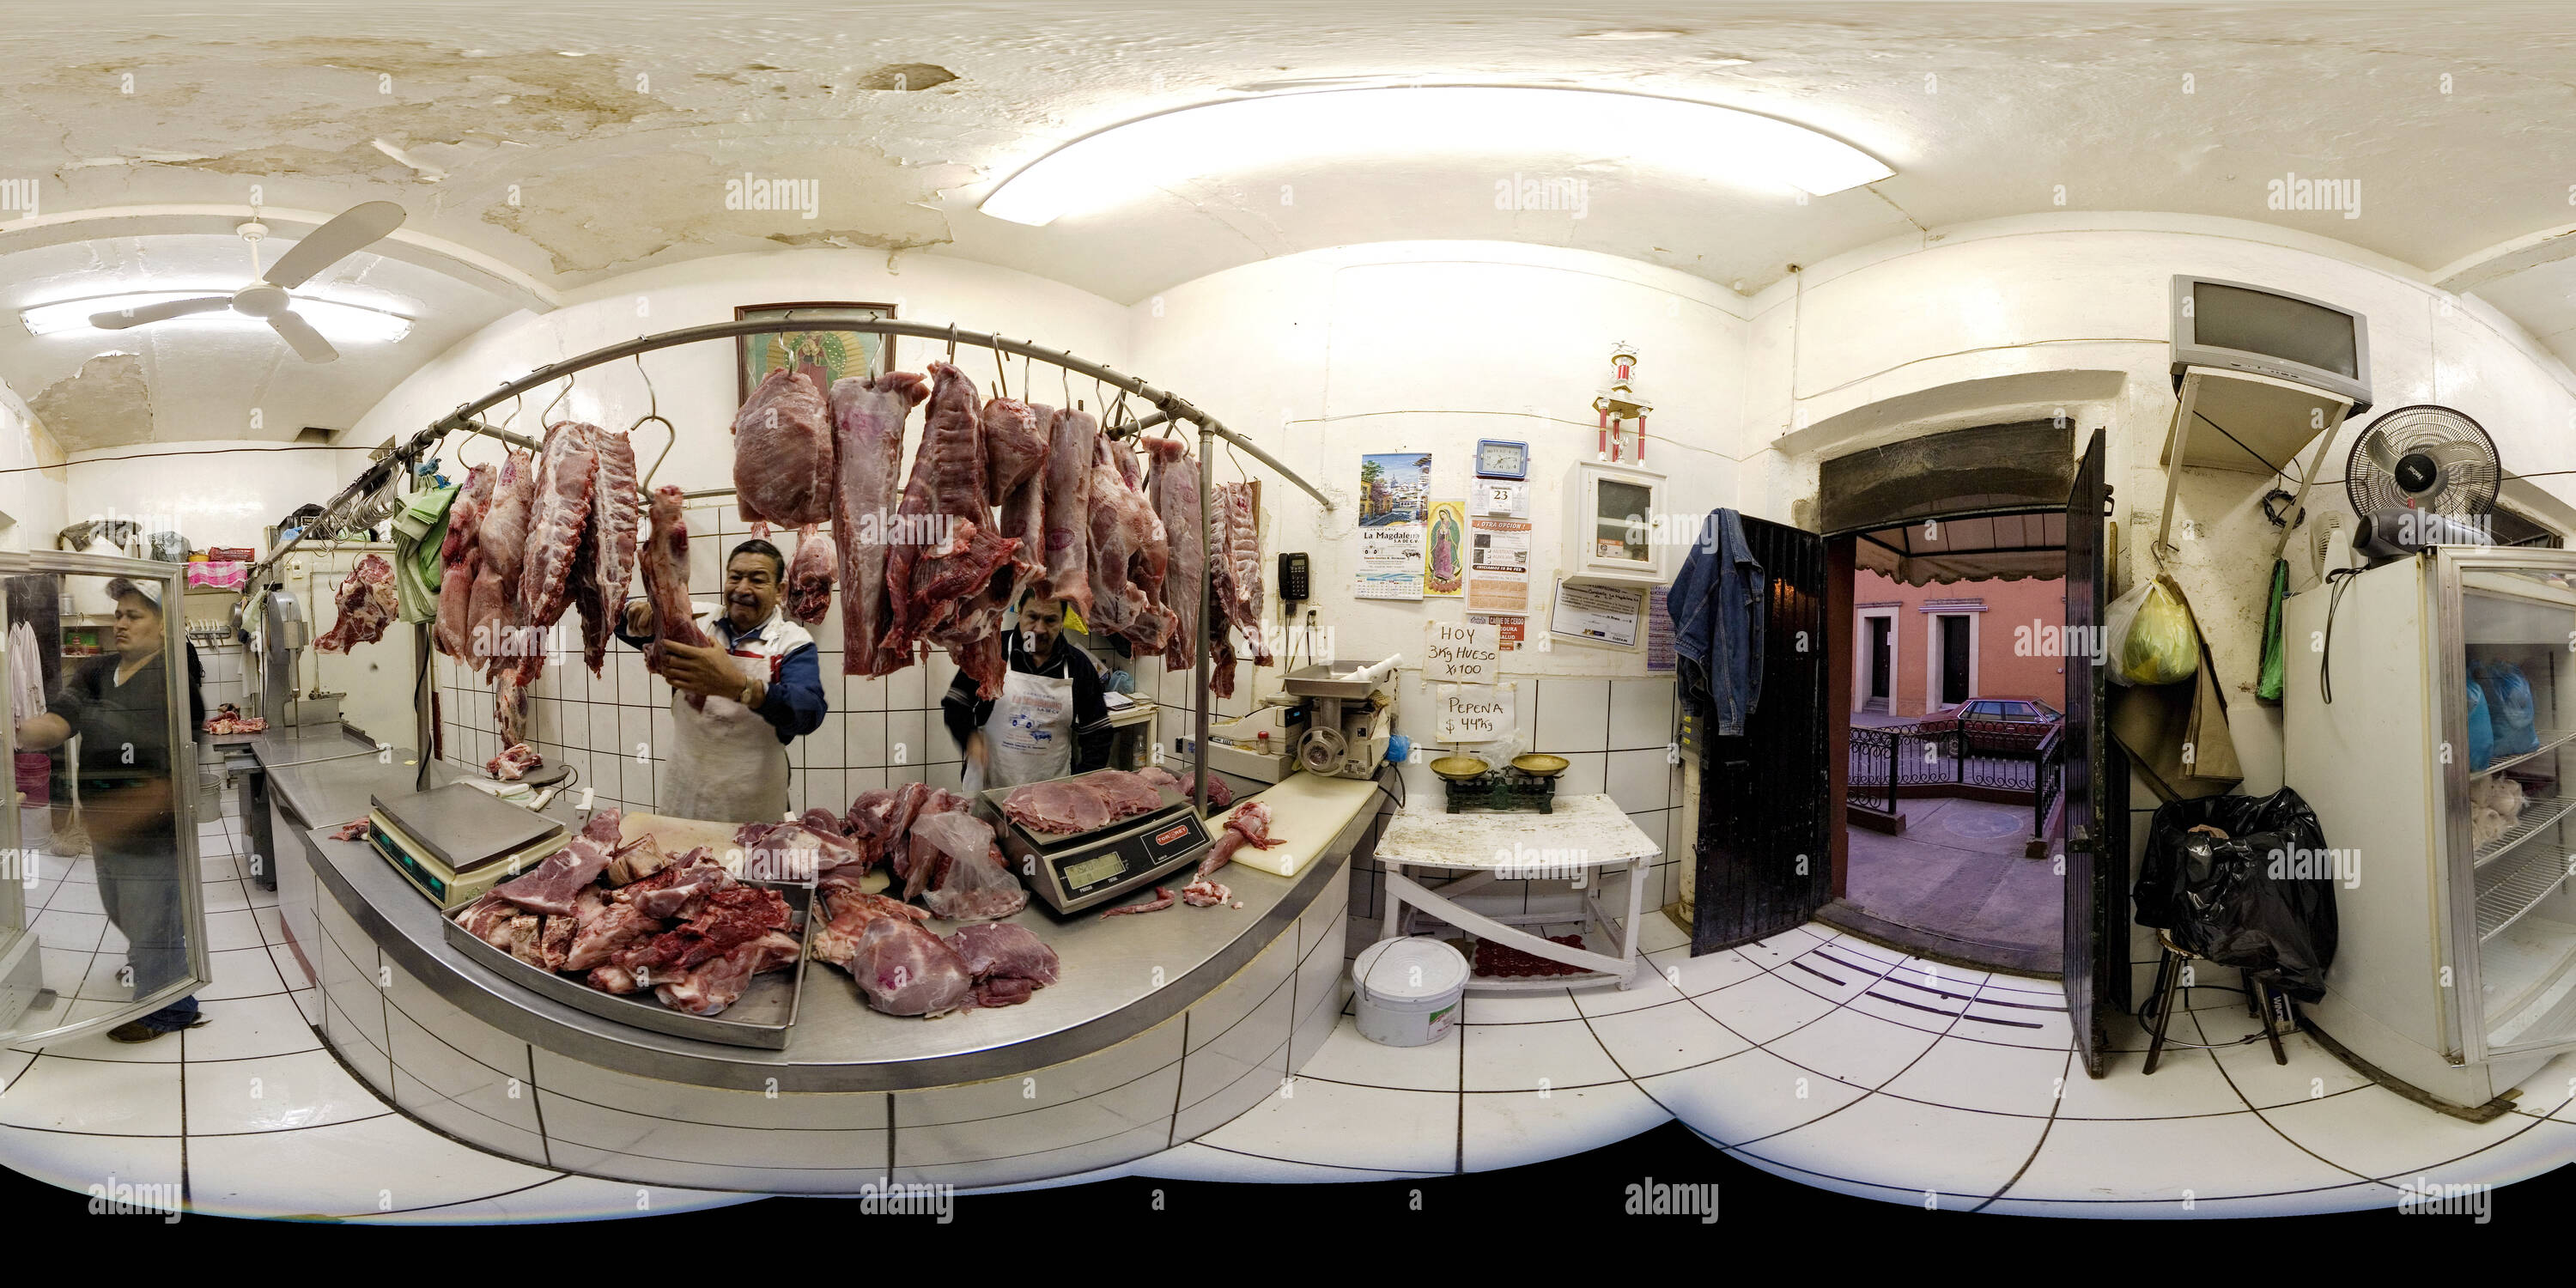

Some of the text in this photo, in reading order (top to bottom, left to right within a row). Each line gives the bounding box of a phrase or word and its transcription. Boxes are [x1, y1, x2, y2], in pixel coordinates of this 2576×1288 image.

[1494, 490, 1508, 500] 23
[1442, 626, 1475, 644] HOY
[1456, 647, 1496, 660] HUESO
[1449, 697, 1504, 714] PEPENA
